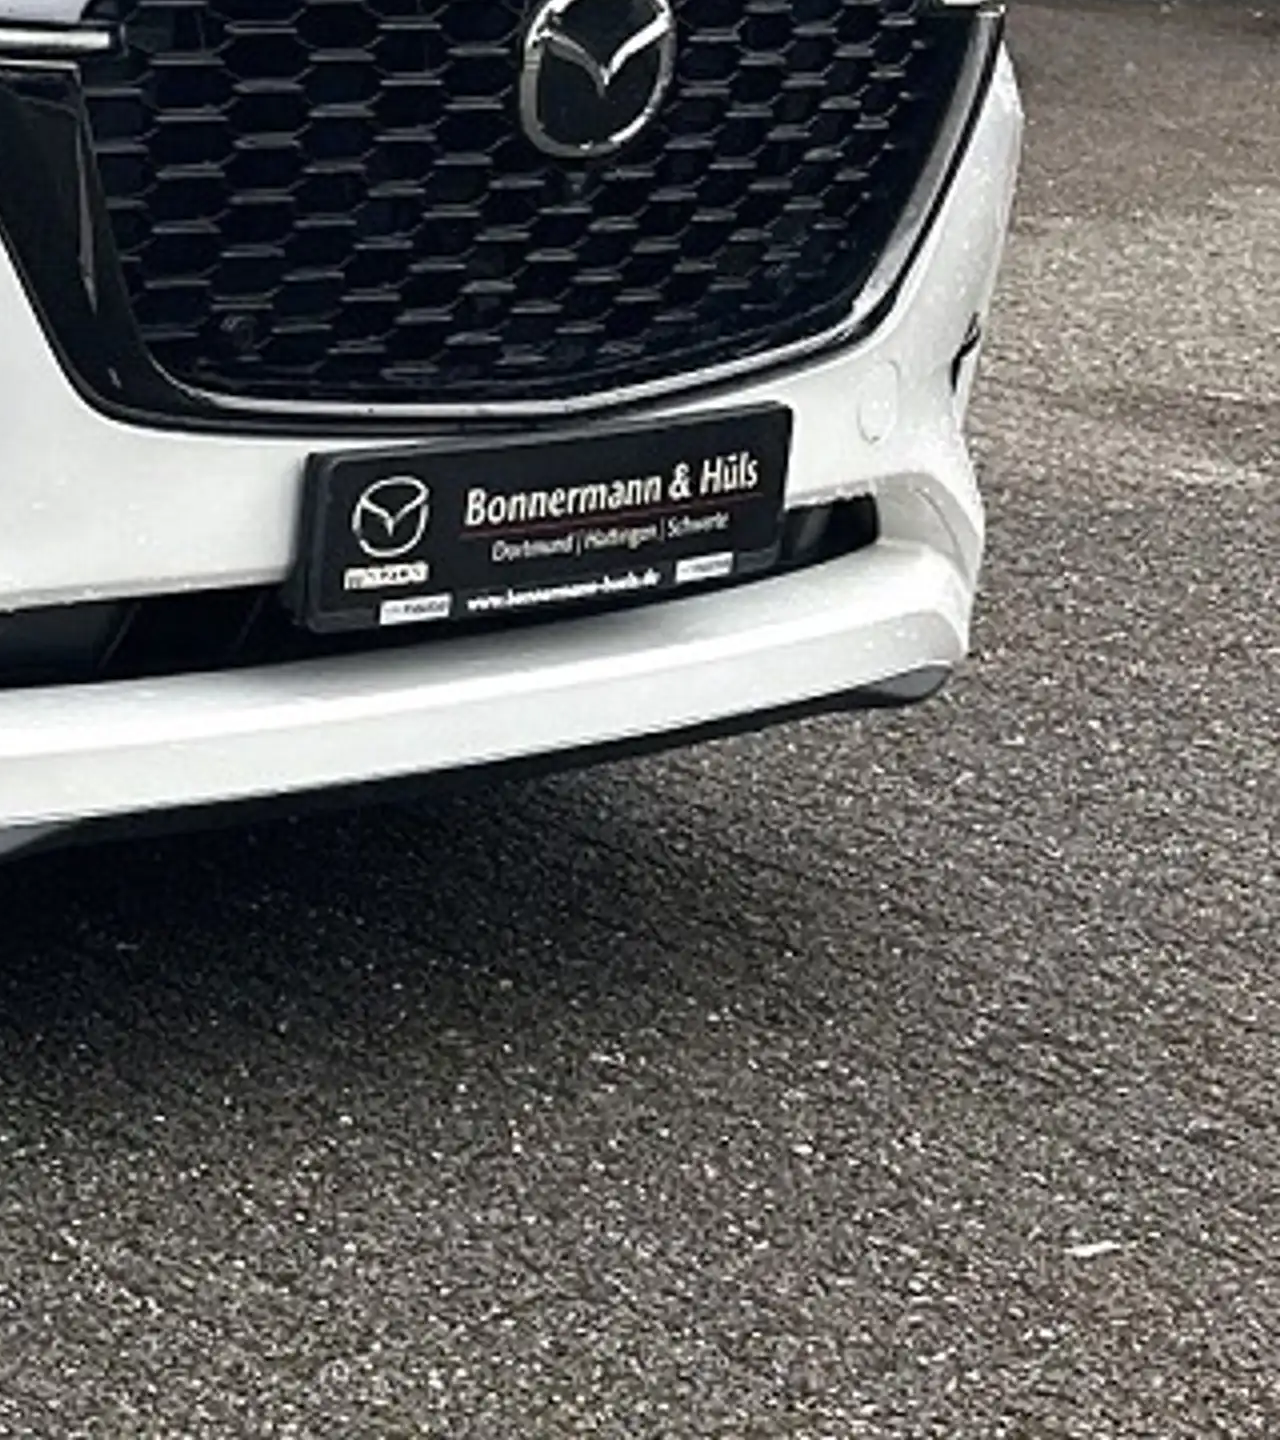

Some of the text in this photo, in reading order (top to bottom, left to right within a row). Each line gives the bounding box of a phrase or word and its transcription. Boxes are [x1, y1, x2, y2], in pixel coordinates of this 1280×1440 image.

[465, 452, 759, 525] Bonnermann & Hüls
